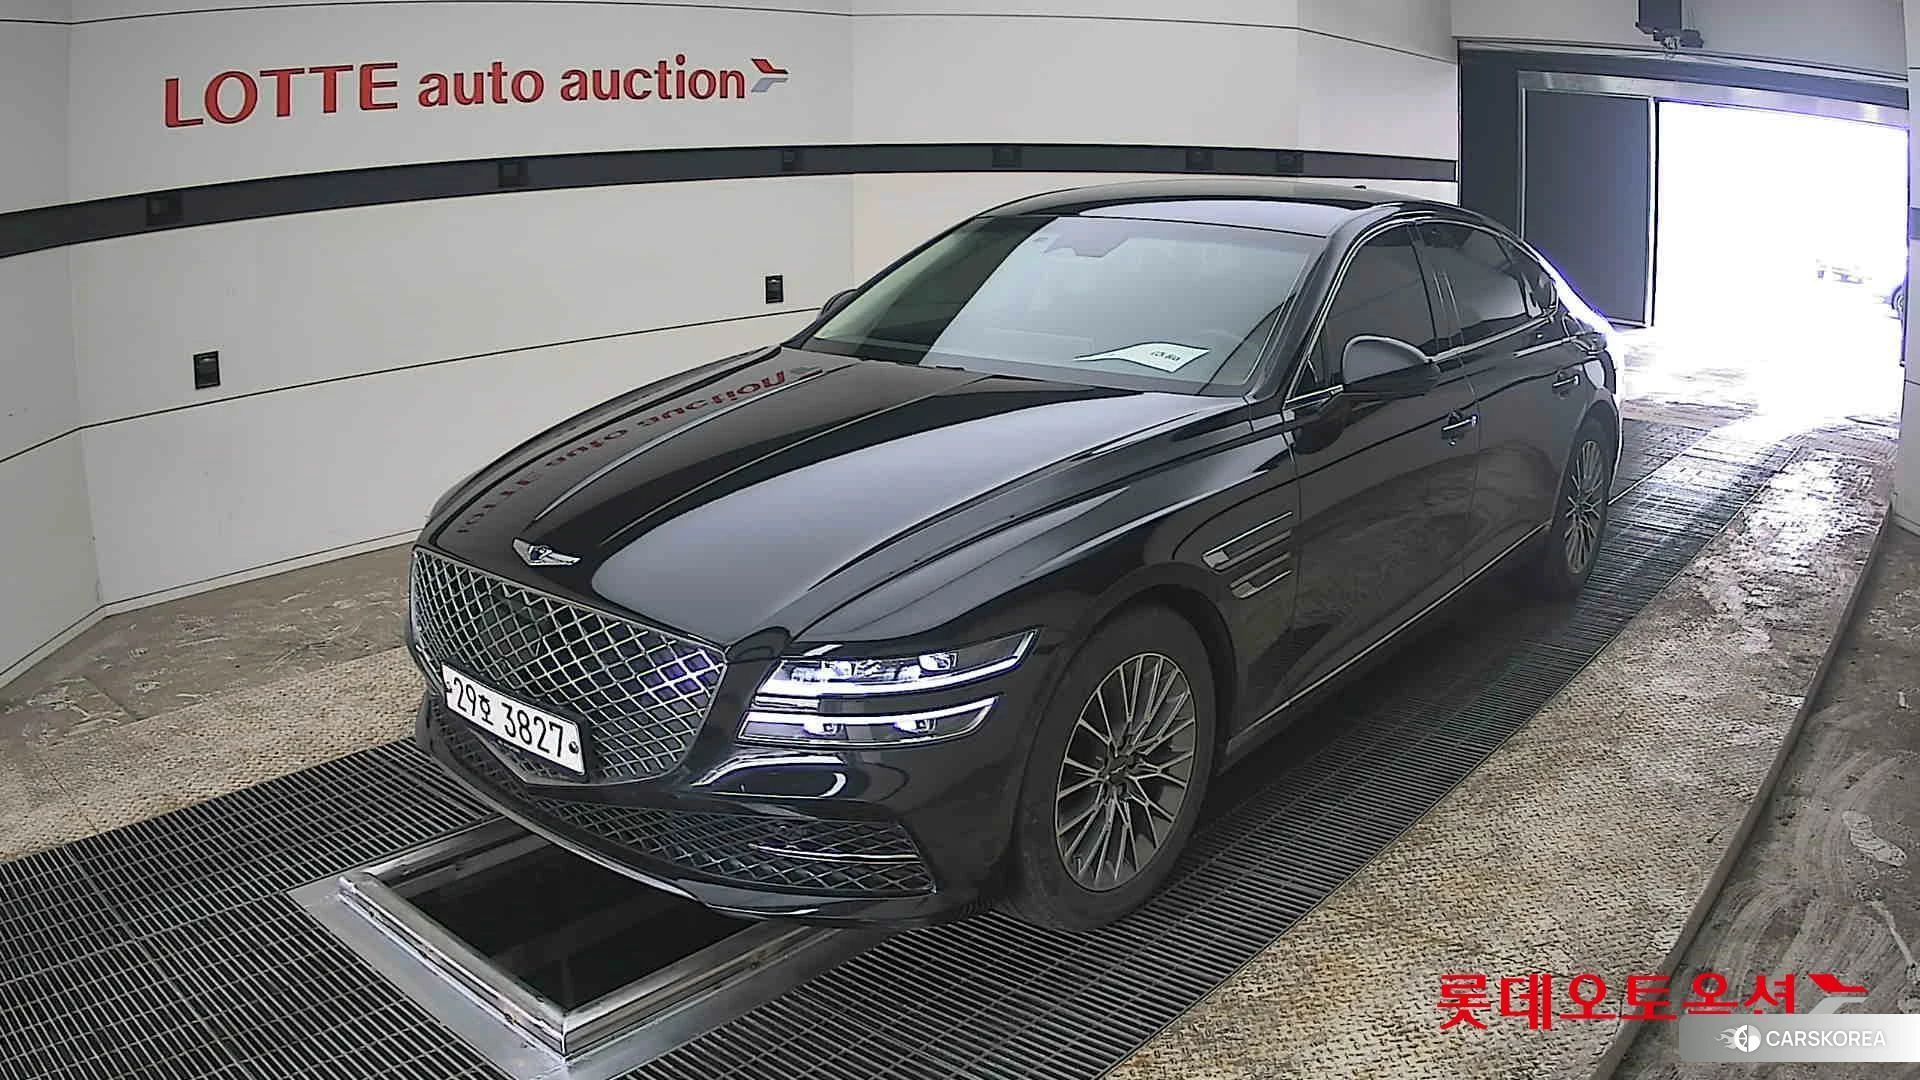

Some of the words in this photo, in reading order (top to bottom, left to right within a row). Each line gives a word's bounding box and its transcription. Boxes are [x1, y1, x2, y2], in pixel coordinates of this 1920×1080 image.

[164, 62, 399, 129] LOTTE
[417, 61, 546, 108] auto
[560, 53, 747, 101] auction
[453, 676, 494, 726] 29호
[501, 701, 564, 758] 3827
